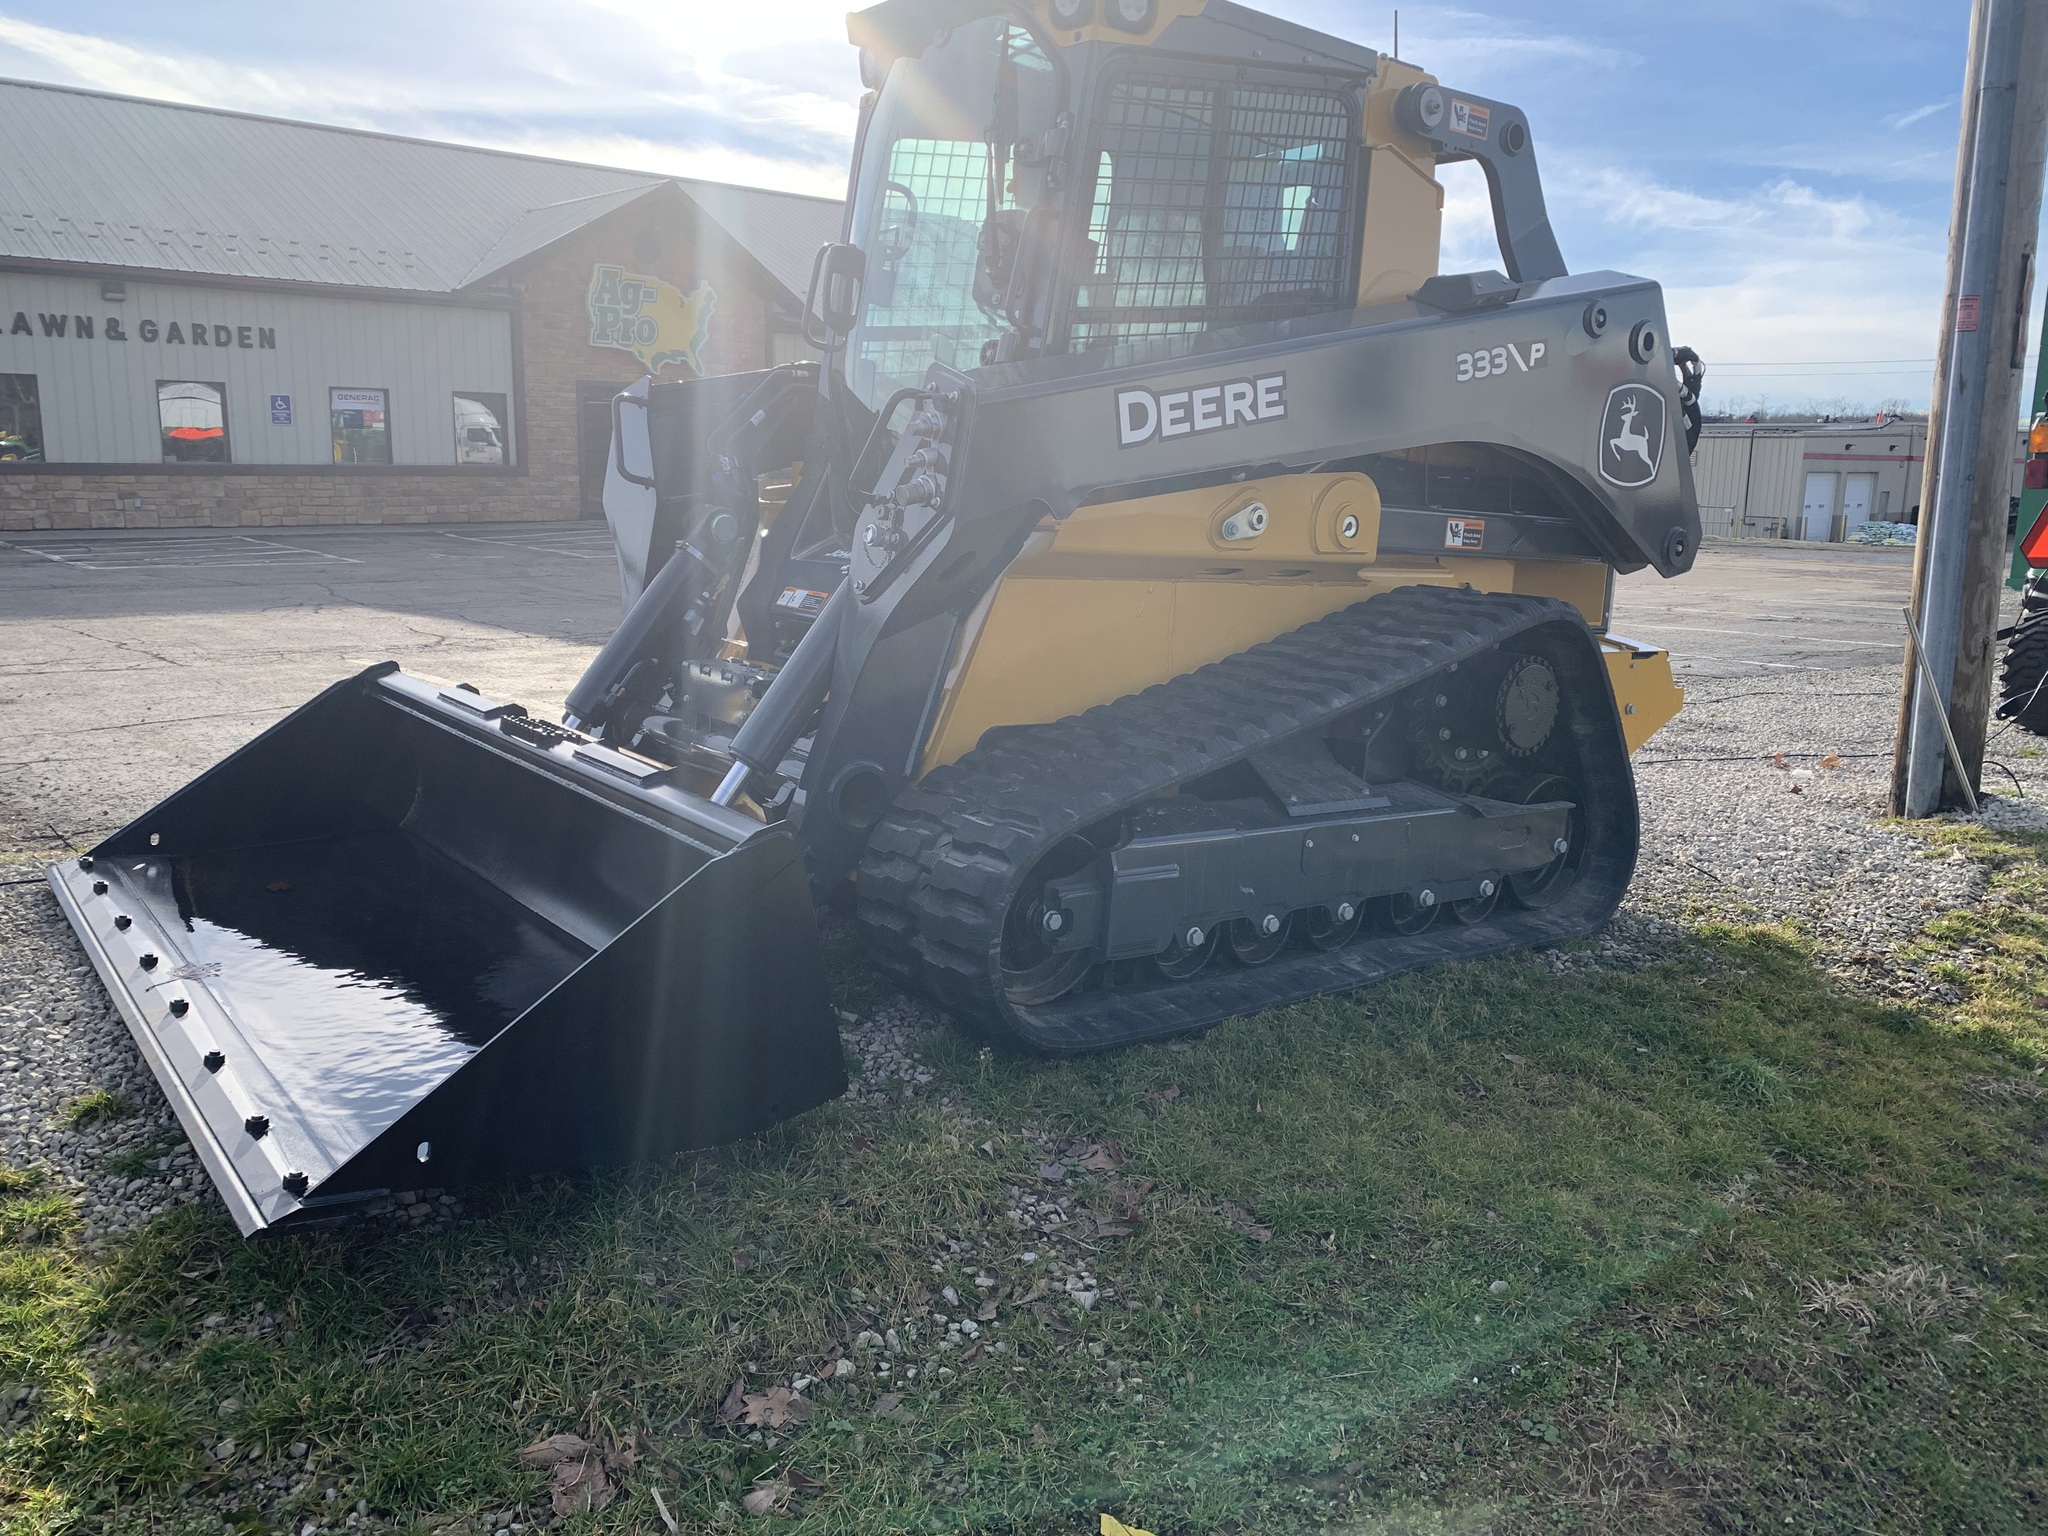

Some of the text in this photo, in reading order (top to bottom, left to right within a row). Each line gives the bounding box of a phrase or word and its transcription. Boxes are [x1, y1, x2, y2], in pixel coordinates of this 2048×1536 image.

[592, 266, 657, 317] Ag-
[0, 311, 277, 350] AWN & GARDEN
[594, 304, 658, 345] Pro
[337, 393, 380, 402] GENERAC
[1118, 376, 1284, 444] DEERE
